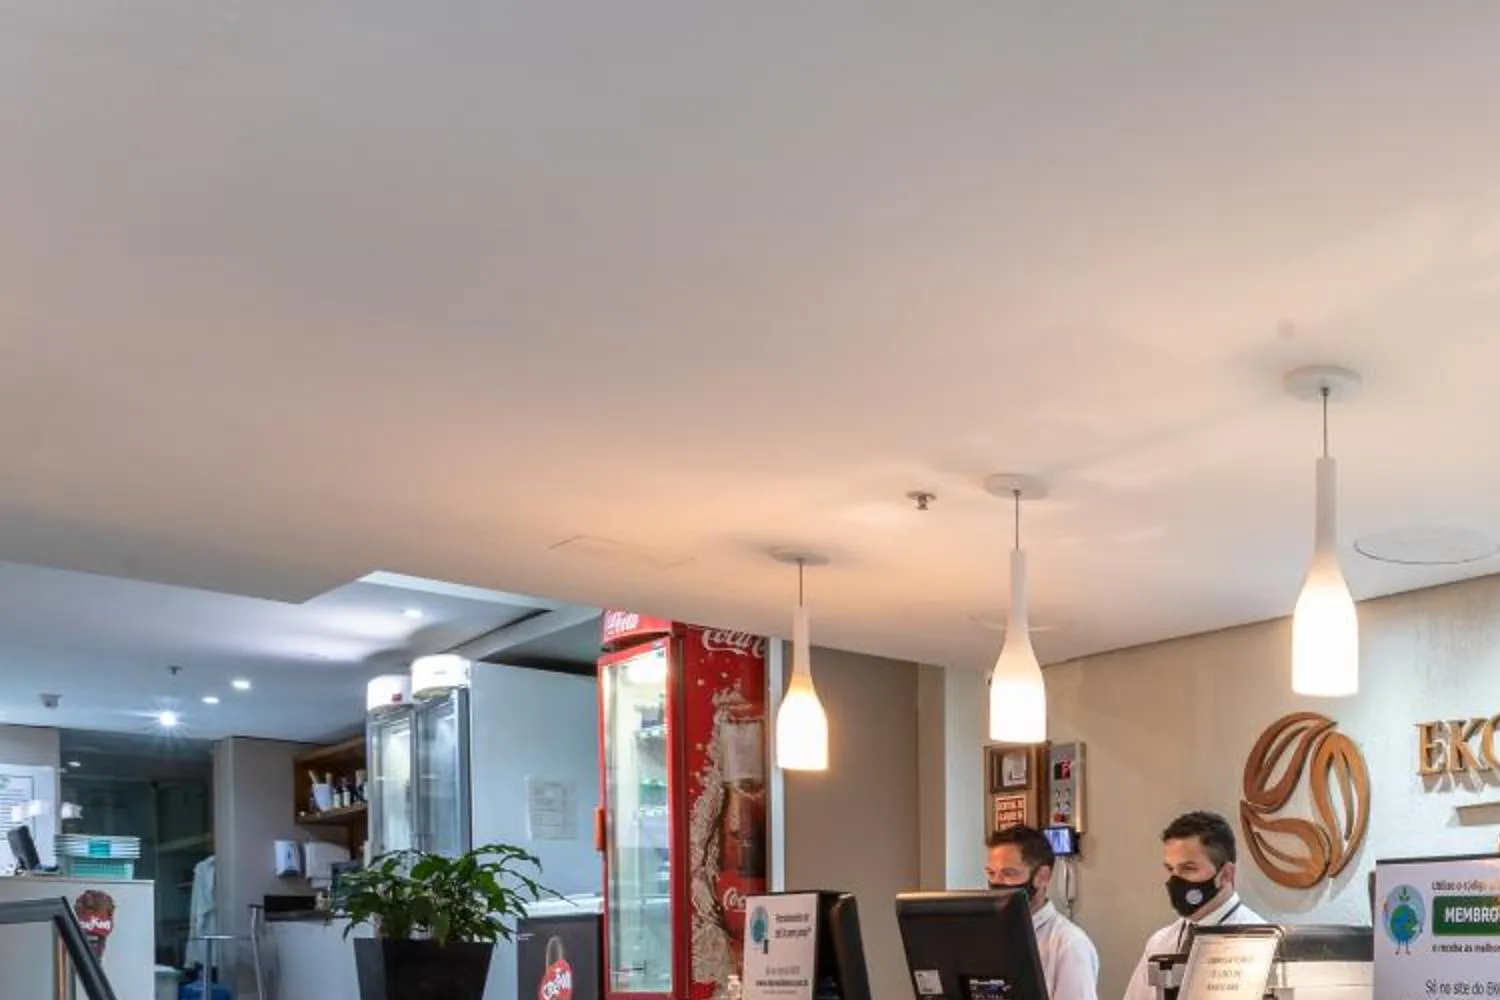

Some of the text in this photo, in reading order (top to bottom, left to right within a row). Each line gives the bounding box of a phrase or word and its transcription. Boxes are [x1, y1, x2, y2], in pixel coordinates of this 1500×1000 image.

[1439, 983, 1452, 994] no
[1453, 981, 1469, 995] site
[1471, 981, 1485, 994] do
